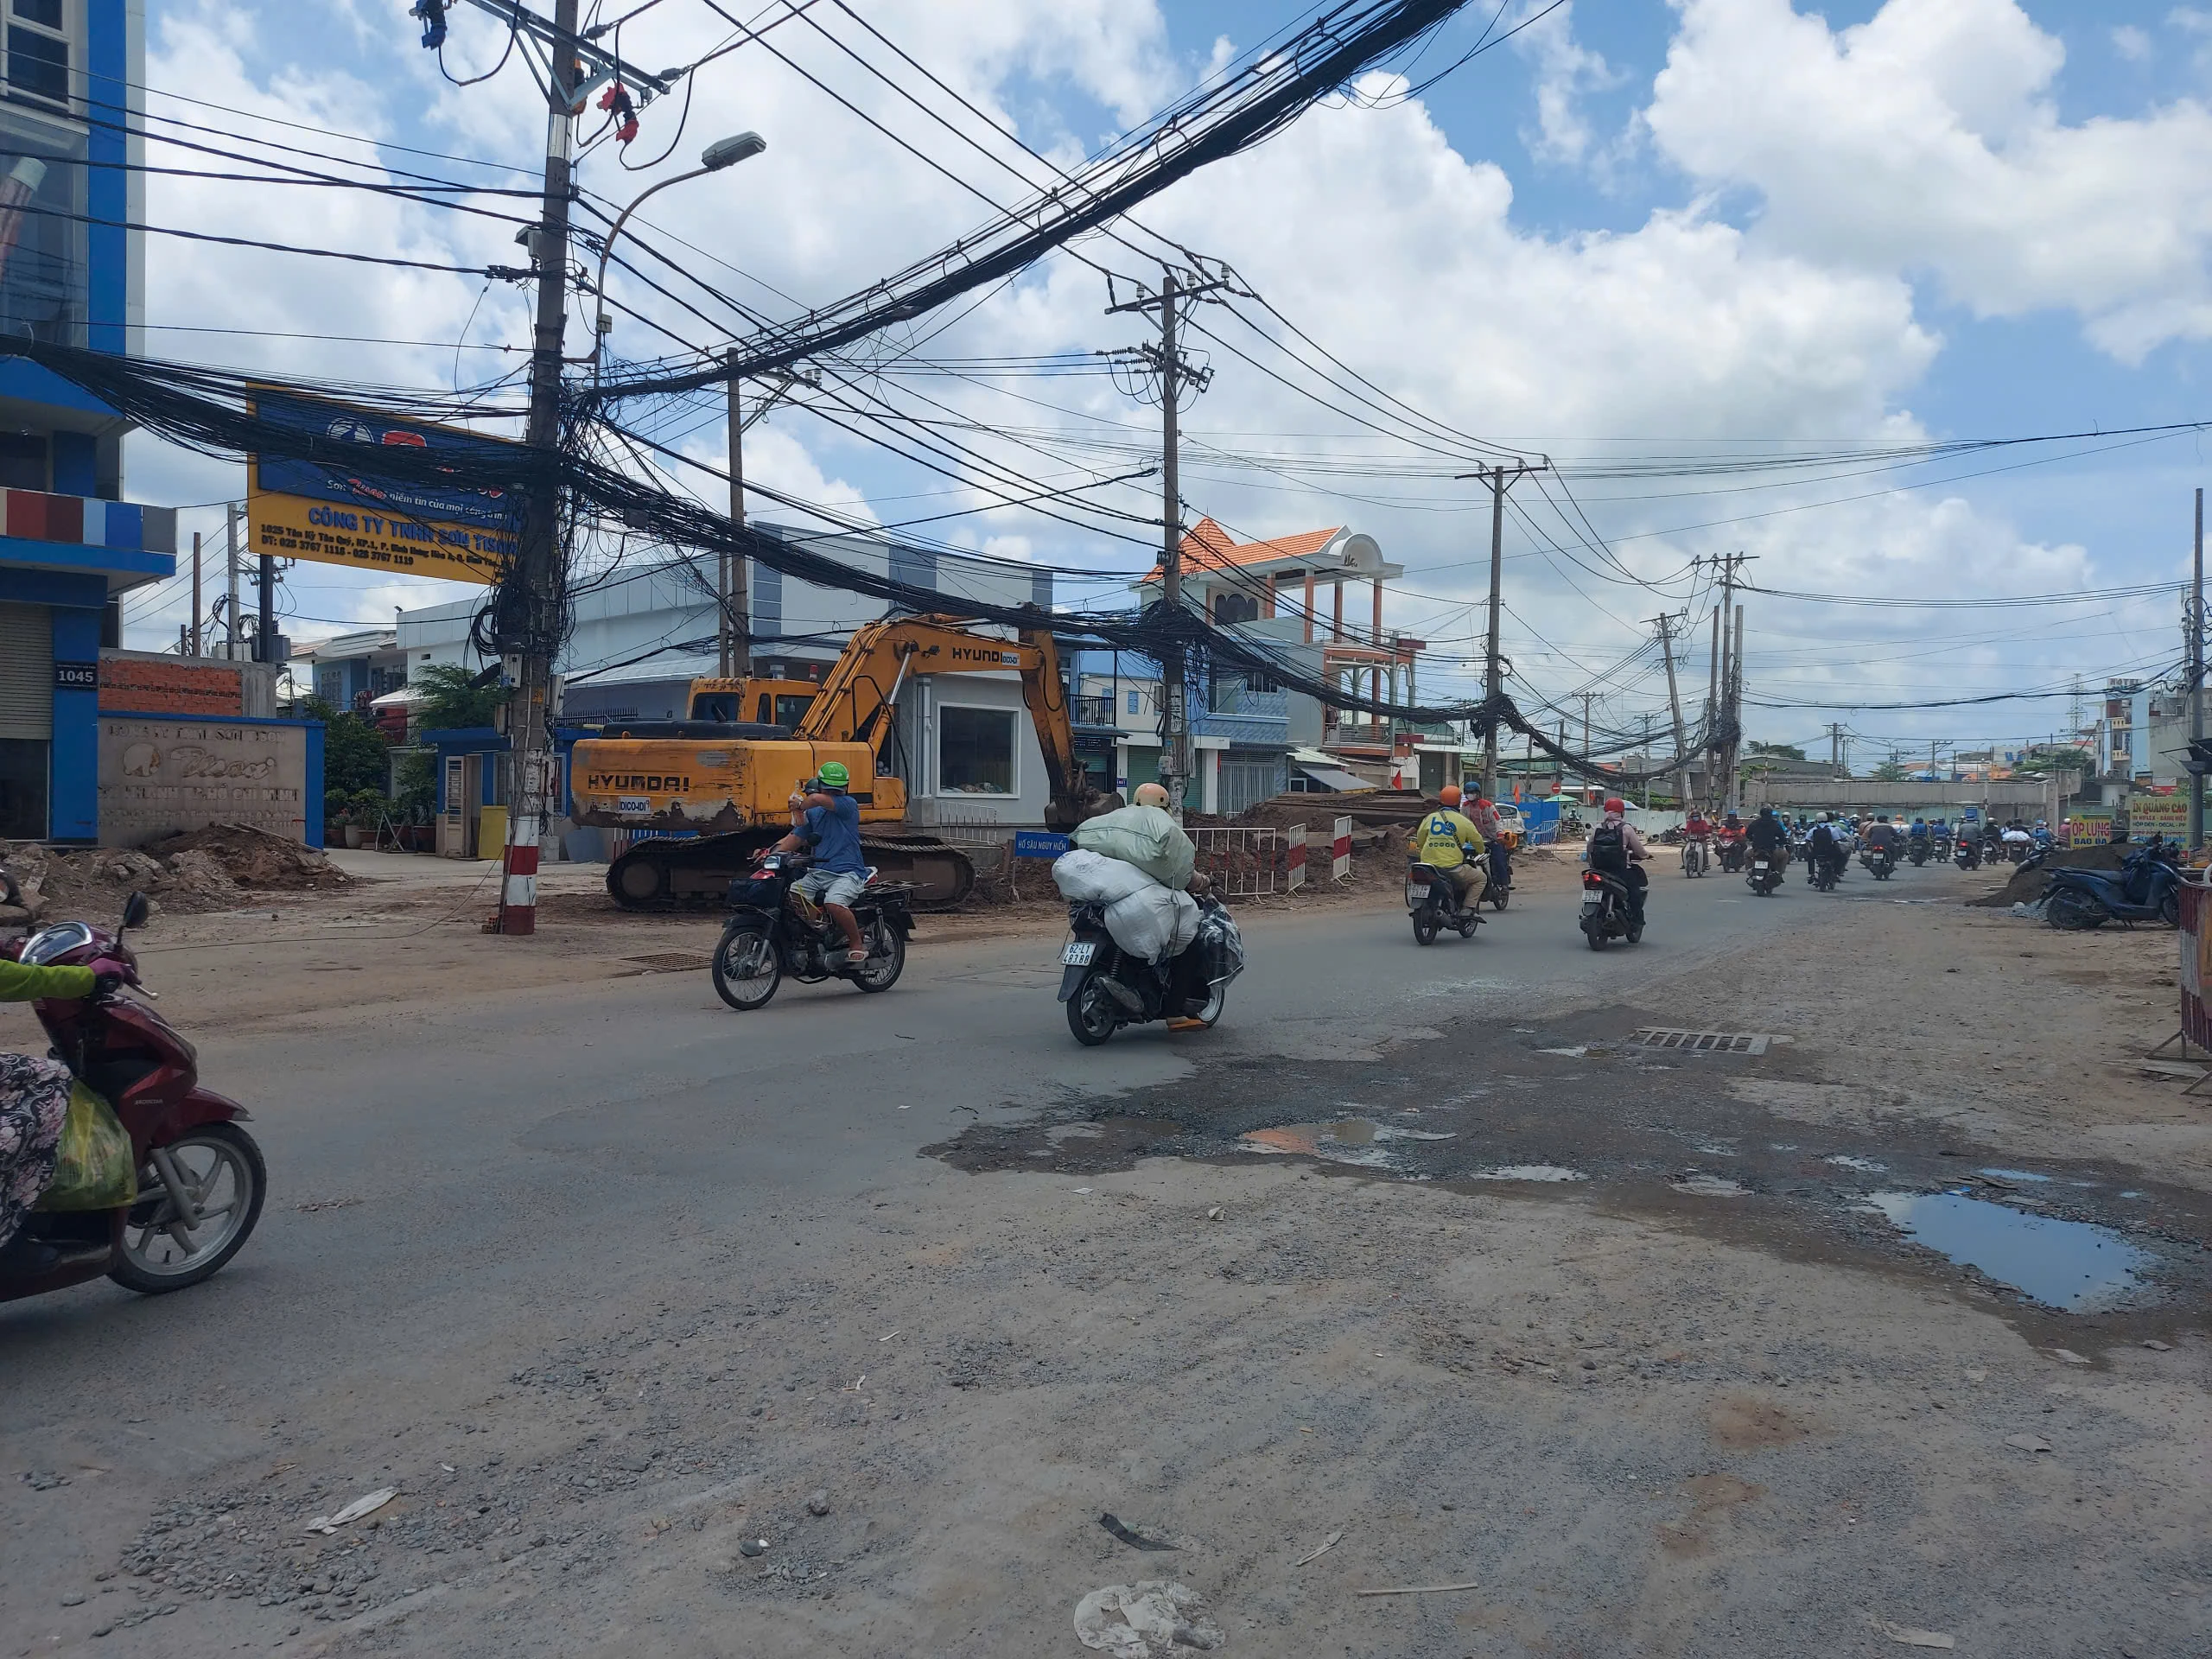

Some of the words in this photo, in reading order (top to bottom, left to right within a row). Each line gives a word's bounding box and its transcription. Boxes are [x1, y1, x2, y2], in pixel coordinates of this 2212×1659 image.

[415, 496, 427, 506] tin
[308, 505, 359, 531] CÔNG
[362, 516, 385, 535] TY
[390, 520, 435, 543] TNHH
[59, 671, 94, 683] 1045
